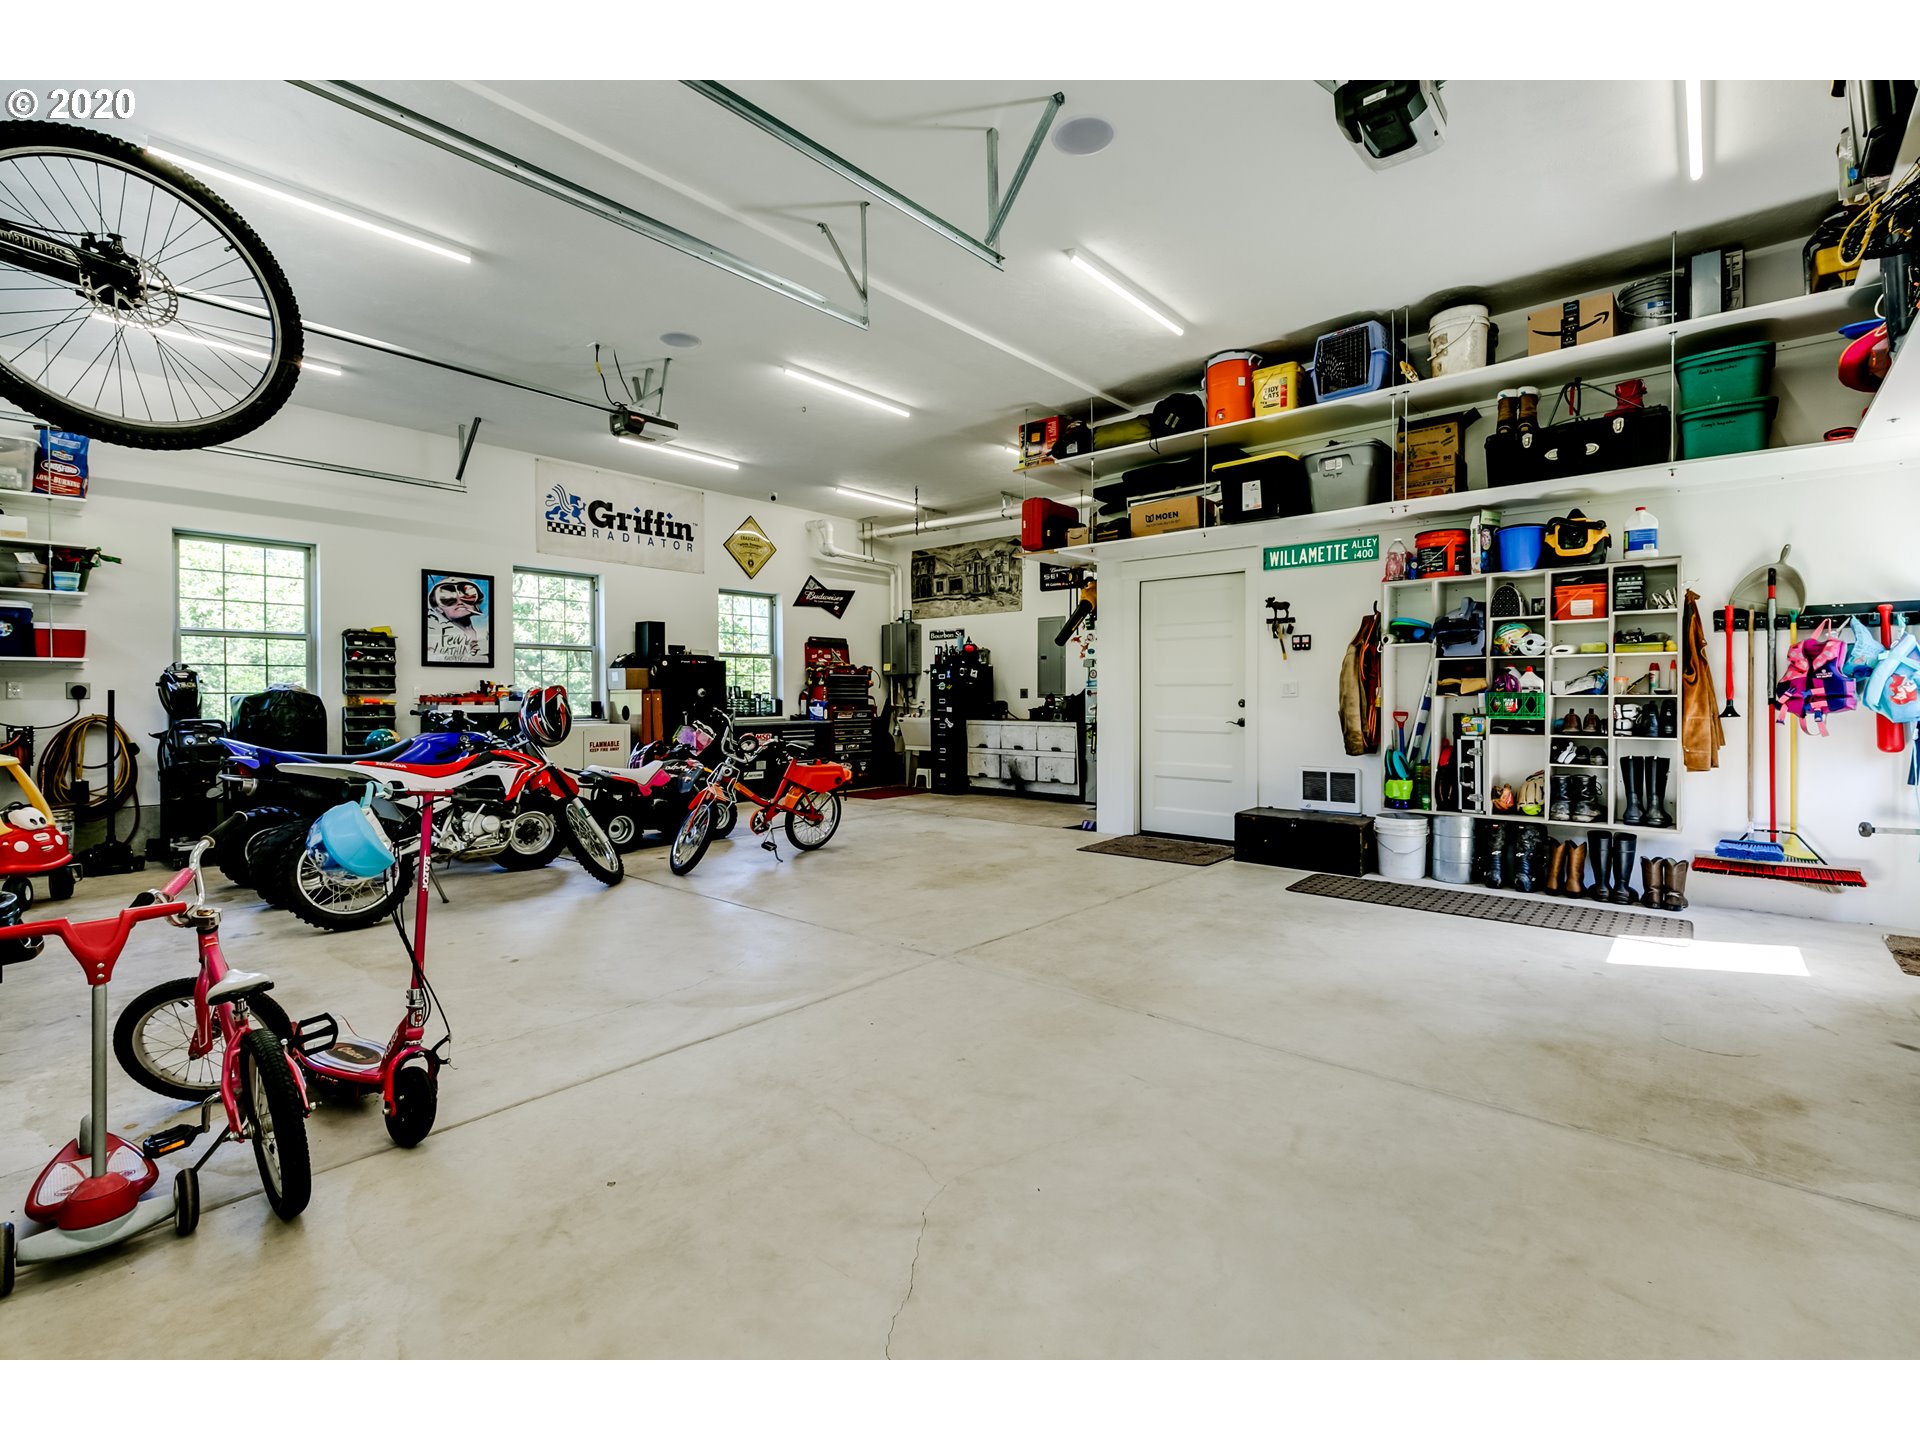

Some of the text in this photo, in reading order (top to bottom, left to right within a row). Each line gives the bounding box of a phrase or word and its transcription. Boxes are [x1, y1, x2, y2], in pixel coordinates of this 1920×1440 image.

[588, 499, 695, 543] Griffin
[1155, 511, 1179, 521] MOEN
[592, 528, 693, 553] RADIATOR
[1269, 537, 1378, 567] WILLAMETTE ALLEY
[804, 591, 844, 602] Budweiser
[930, 631, 954, 640] Bourbon
[589, 740, 620, 748] FLAMMABLE
[375, 761, 408, 769] HONDA
